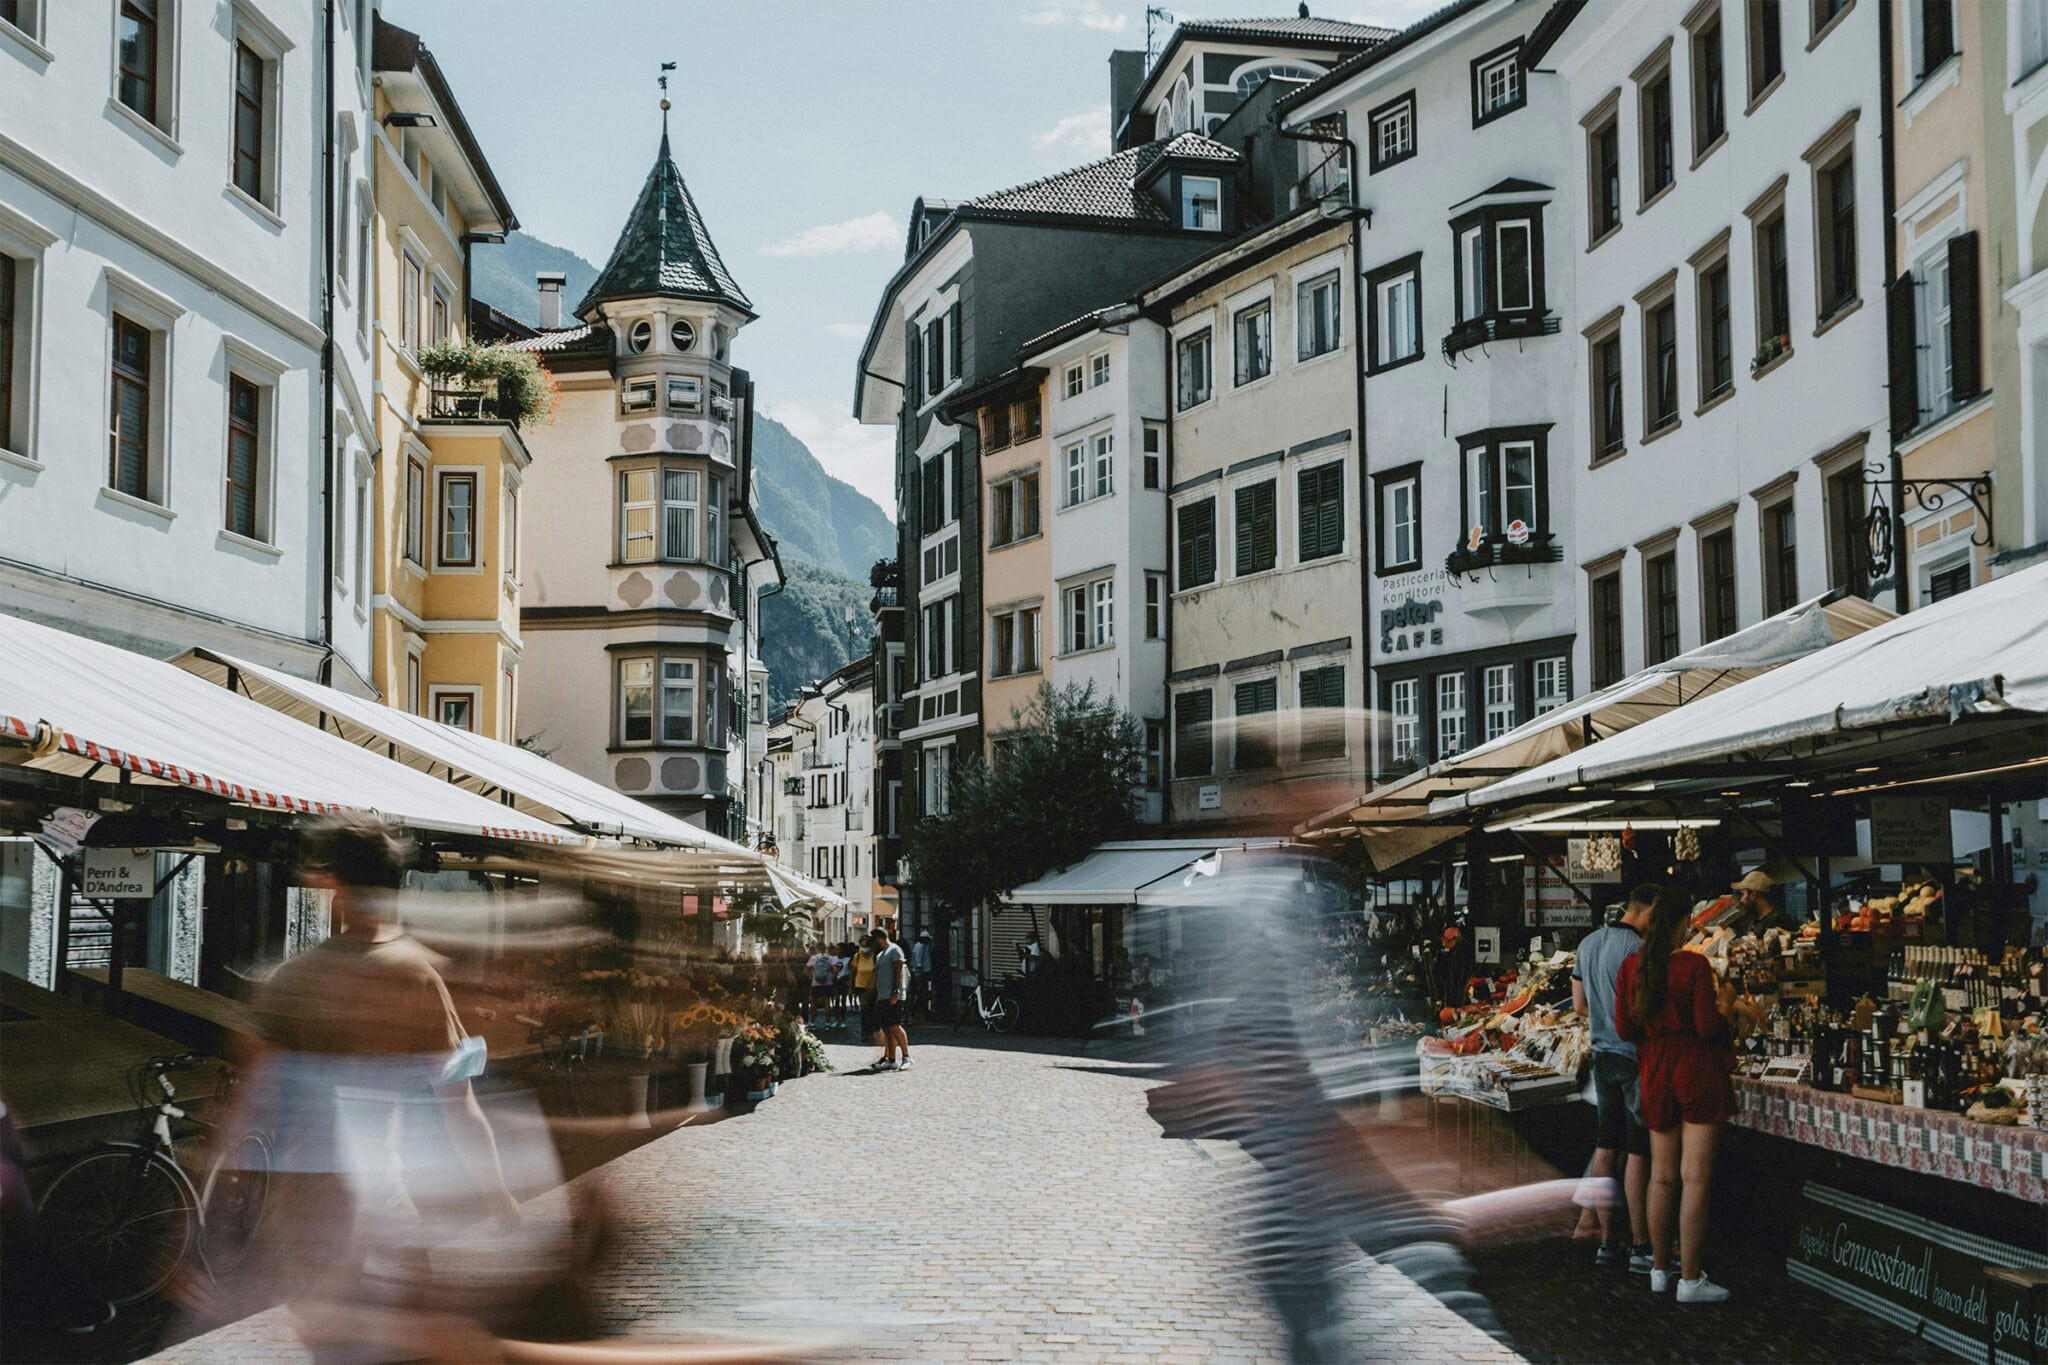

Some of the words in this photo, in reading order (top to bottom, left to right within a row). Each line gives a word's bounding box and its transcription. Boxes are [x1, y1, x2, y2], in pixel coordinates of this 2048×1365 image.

[1383, 568, 1445, 590] Pasticceria
[1383, 581, 1445, 604] Konditorei
[1381, 598, 1443, 637] peter
[1381, 628, 1443, 654] CAFE
[87, 867, 116, 879] Perri
[119, 866, 130, 879] &
[1572, 871, 1604, 879] Italiani
[86, 880, 143, 893] D'Andrea
[1832, 1221, 1932, 1300] Genussstandl
[1932, 1272, 1962, 1314] banco
[1963, 1284, 1988, 1324] dell
